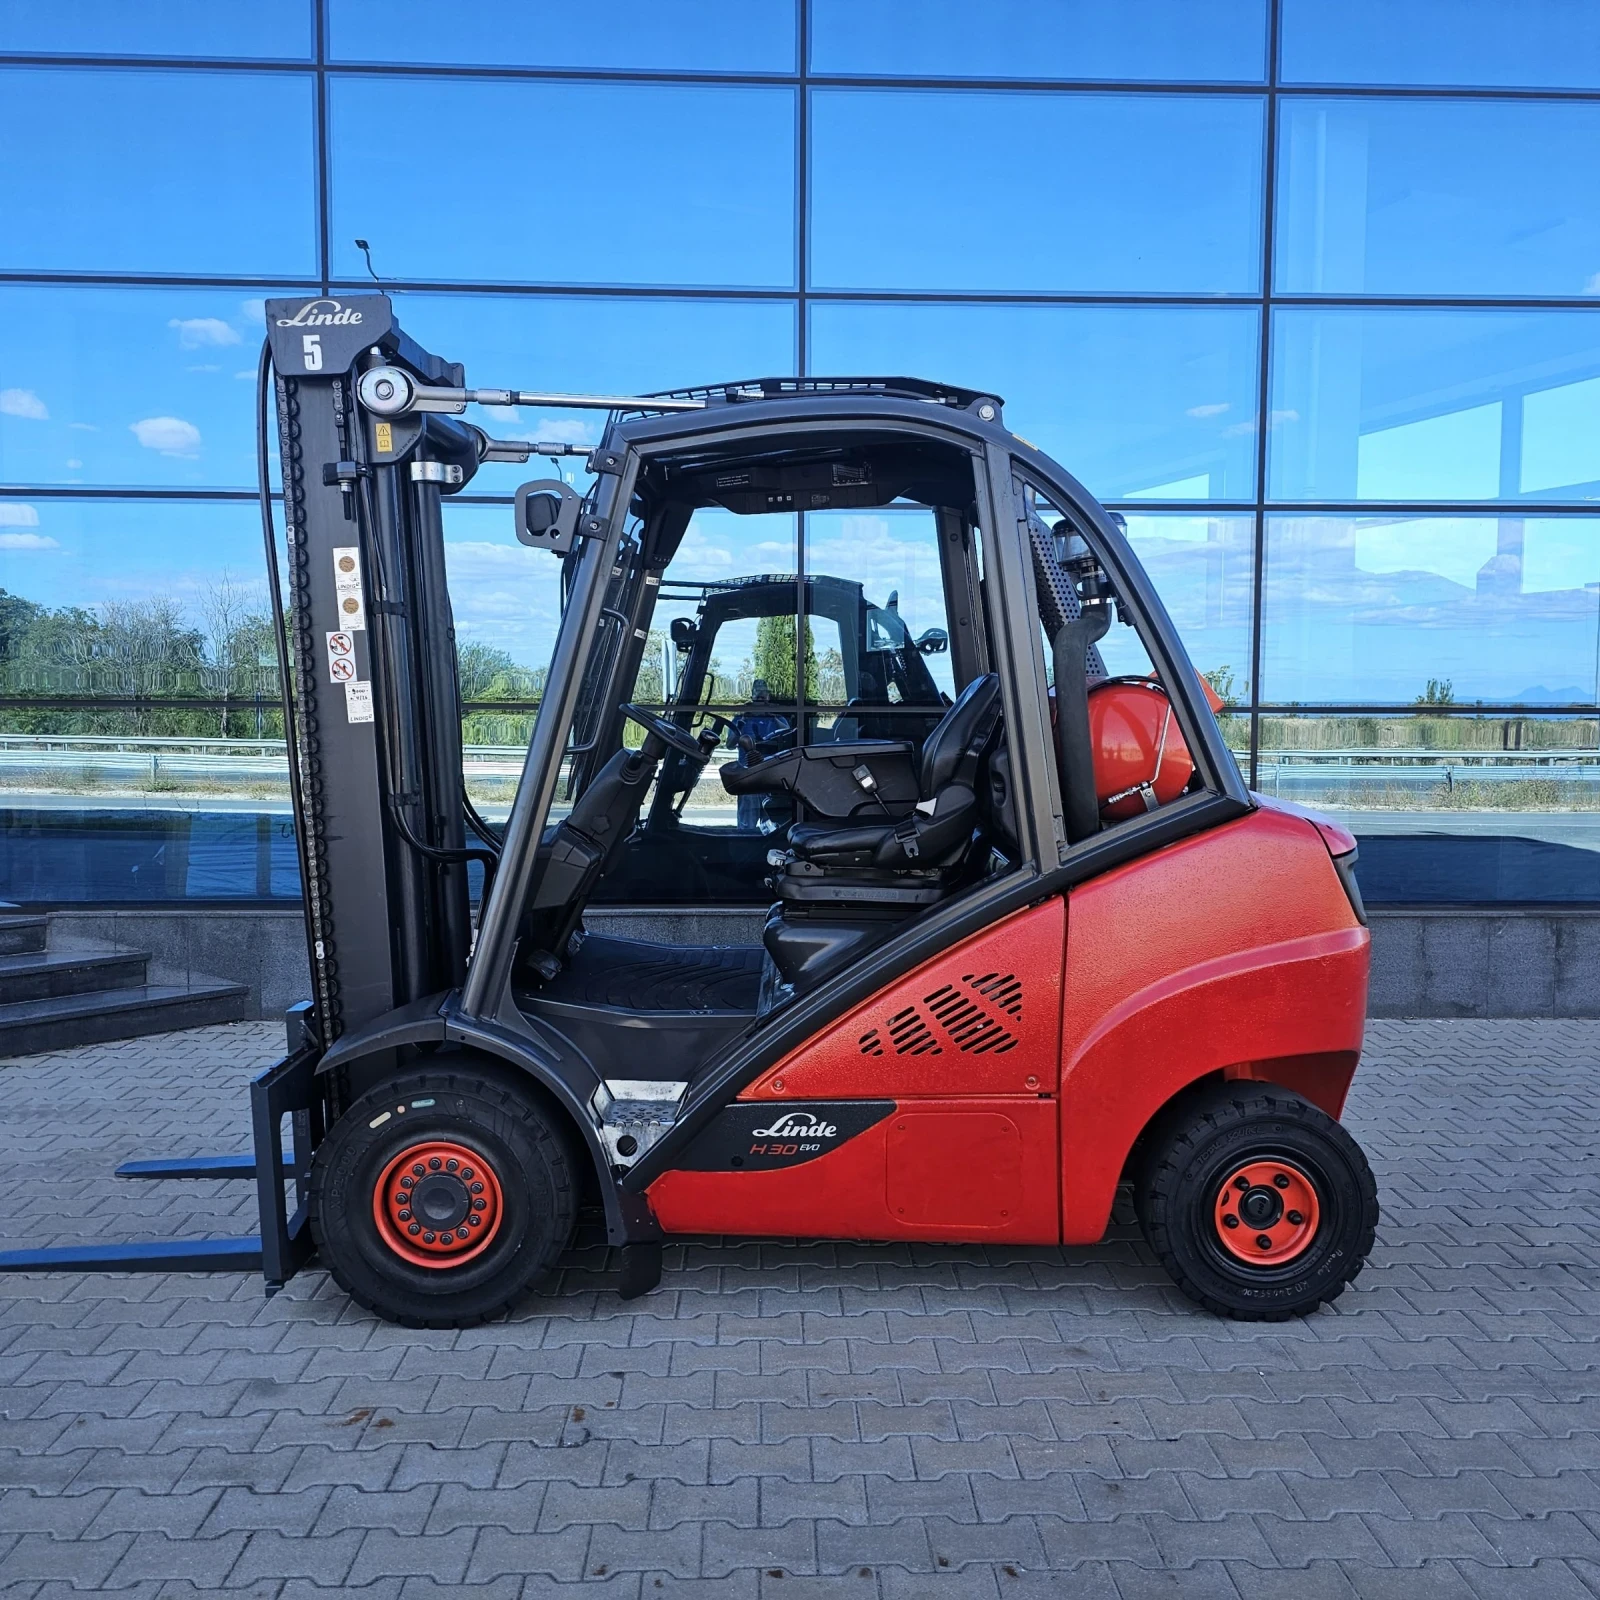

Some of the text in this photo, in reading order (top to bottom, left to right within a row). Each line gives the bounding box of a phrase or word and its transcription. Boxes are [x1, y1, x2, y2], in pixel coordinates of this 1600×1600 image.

[276, 300, 363, 326] Linde
[303, 334, 322, 371] 5
[752, 1112, 837, 1137] Linde
